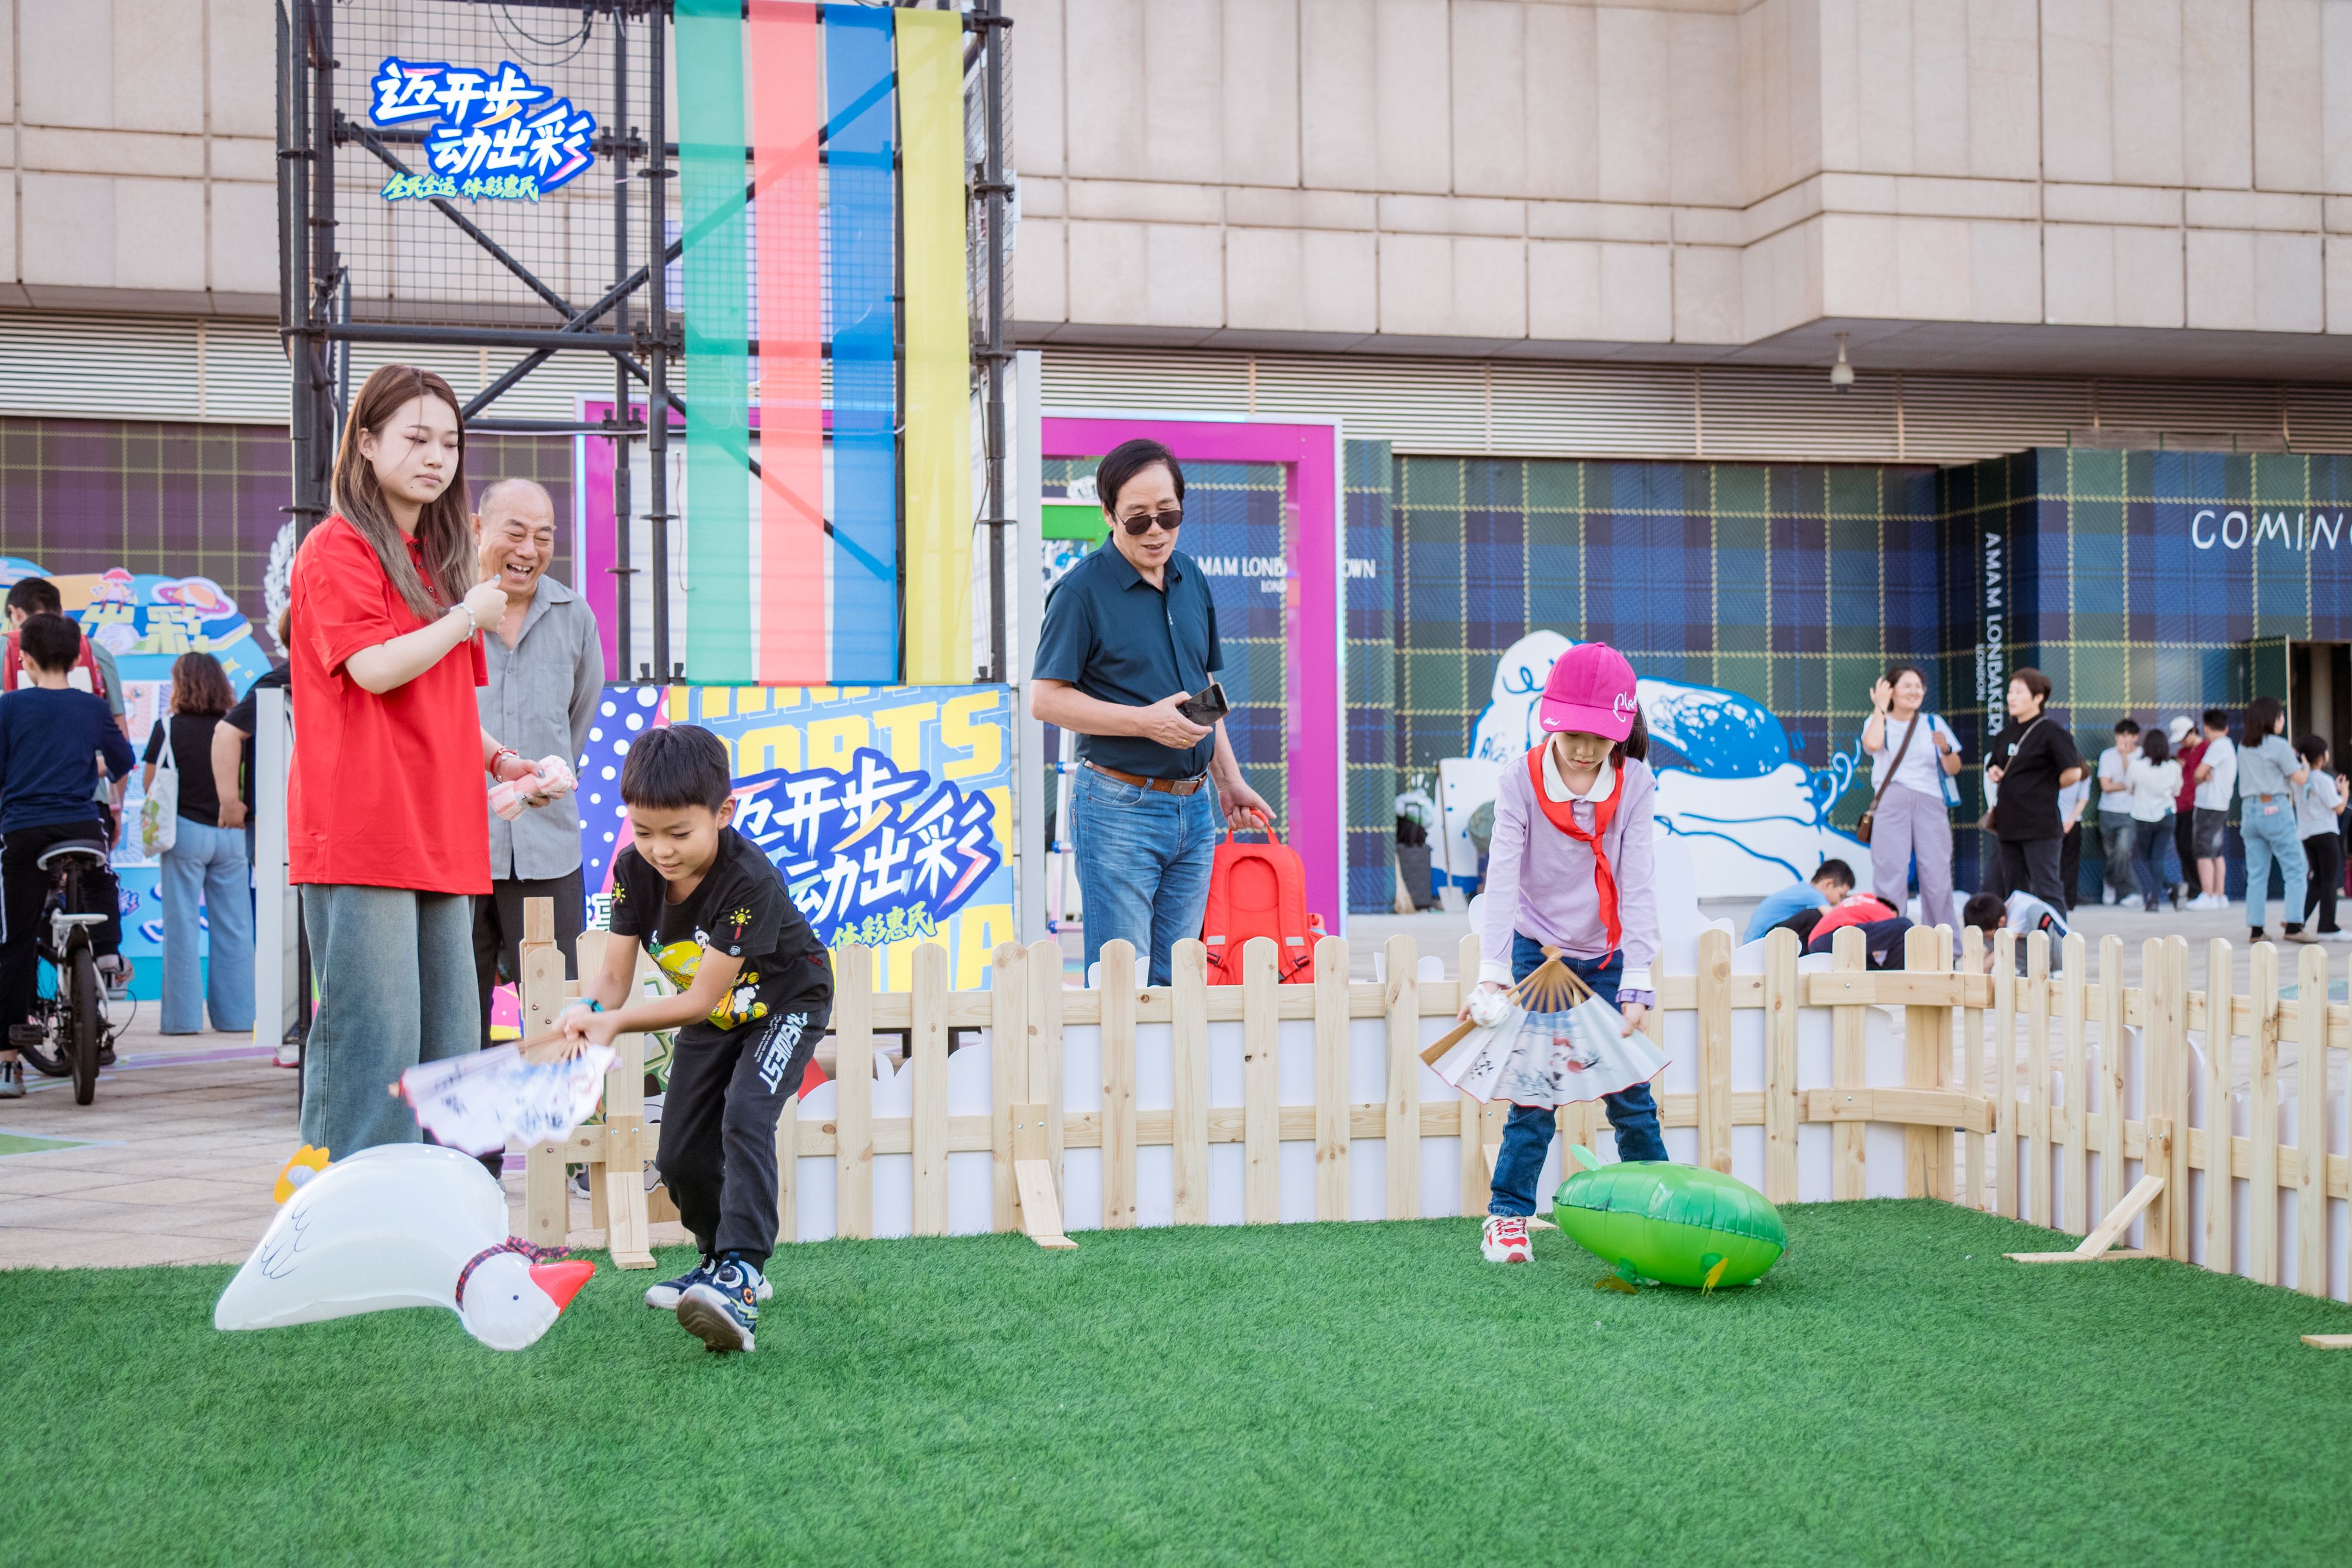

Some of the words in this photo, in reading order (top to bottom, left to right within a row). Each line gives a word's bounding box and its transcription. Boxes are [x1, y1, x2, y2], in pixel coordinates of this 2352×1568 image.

[375, 63, 544, 128] 迈开步
[430, 105, 590, 185] 动出彩
[461, 174, 540, 203] 体彩惠民
[2192, 510, 2352, 551] COMIN
[1189, 556, 1238, 577] MAM
[1342, 558, 1376, 579] OWN
[1261, 579, 1287, 593] LOND
[1985, 531, 2002, 609] AMAM
[1975, 643, 1986, 701] LONDON
[786, 790, 992, 926] 动出彩
